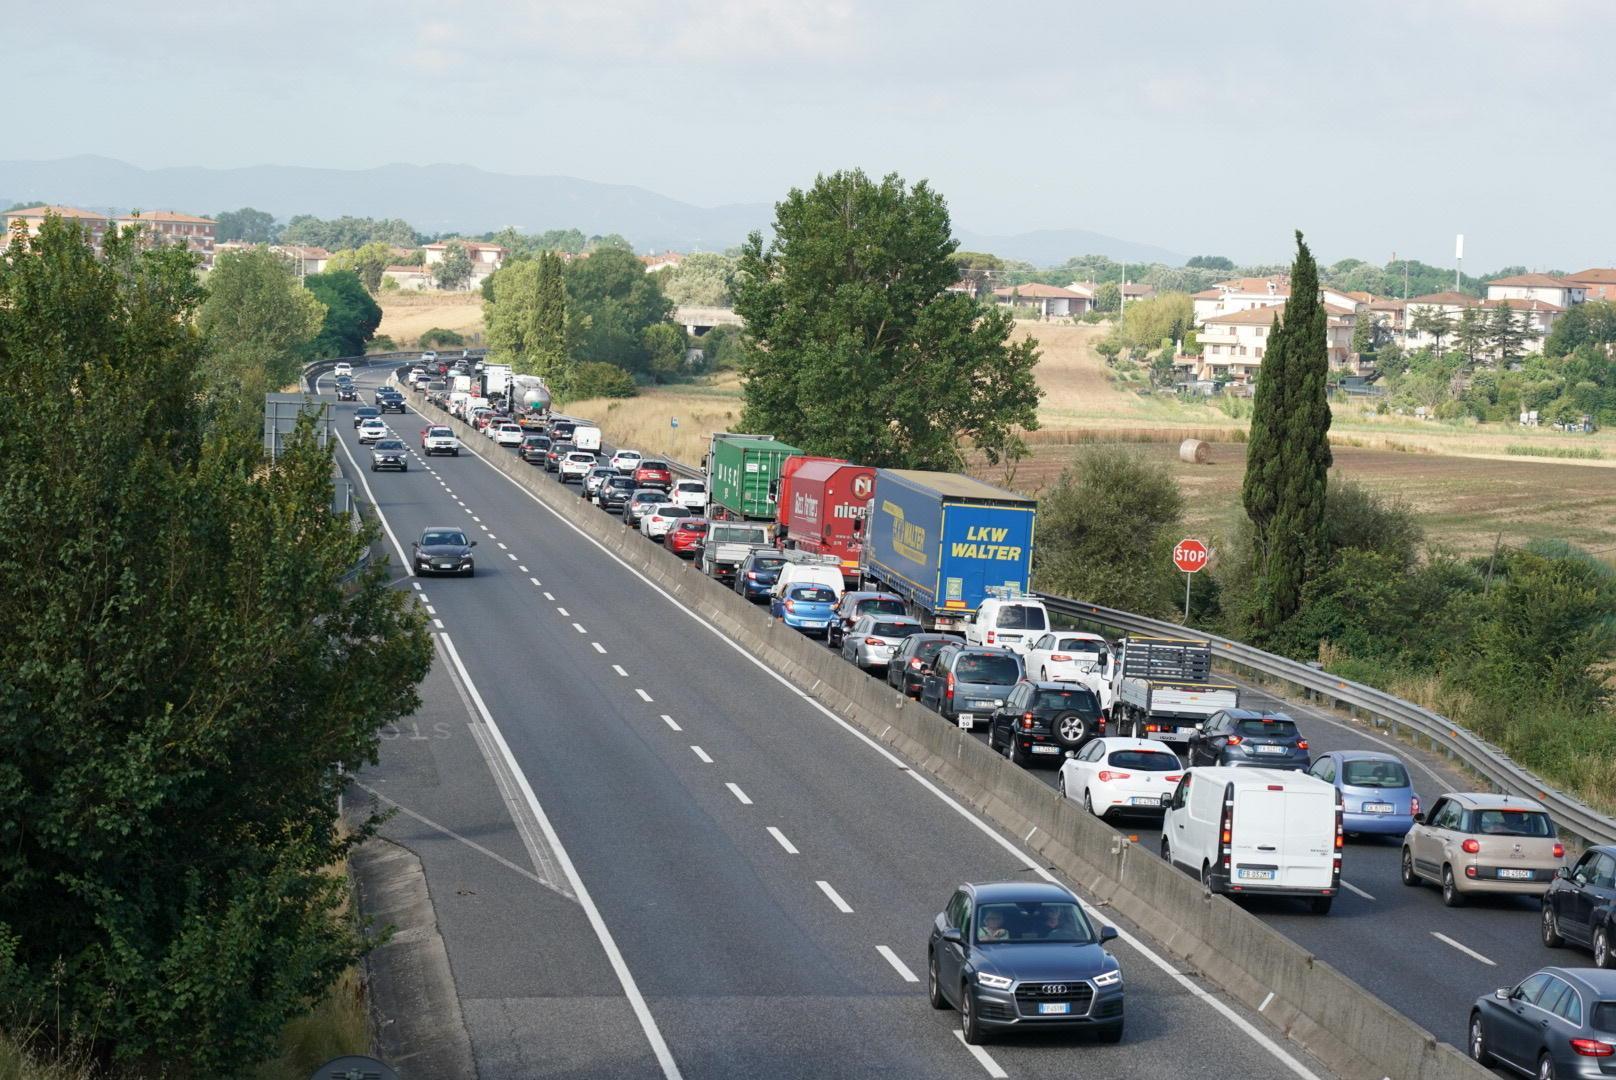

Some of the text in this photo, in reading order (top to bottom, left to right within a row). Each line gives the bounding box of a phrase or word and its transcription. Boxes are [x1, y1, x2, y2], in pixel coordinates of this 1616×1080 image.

[966, 526, 1009, 543] LKW
[951, 542, 1022, 561] WALTER
[1176, 549, 1205, 562] STOP
[375, 721, 453, 740] STO
